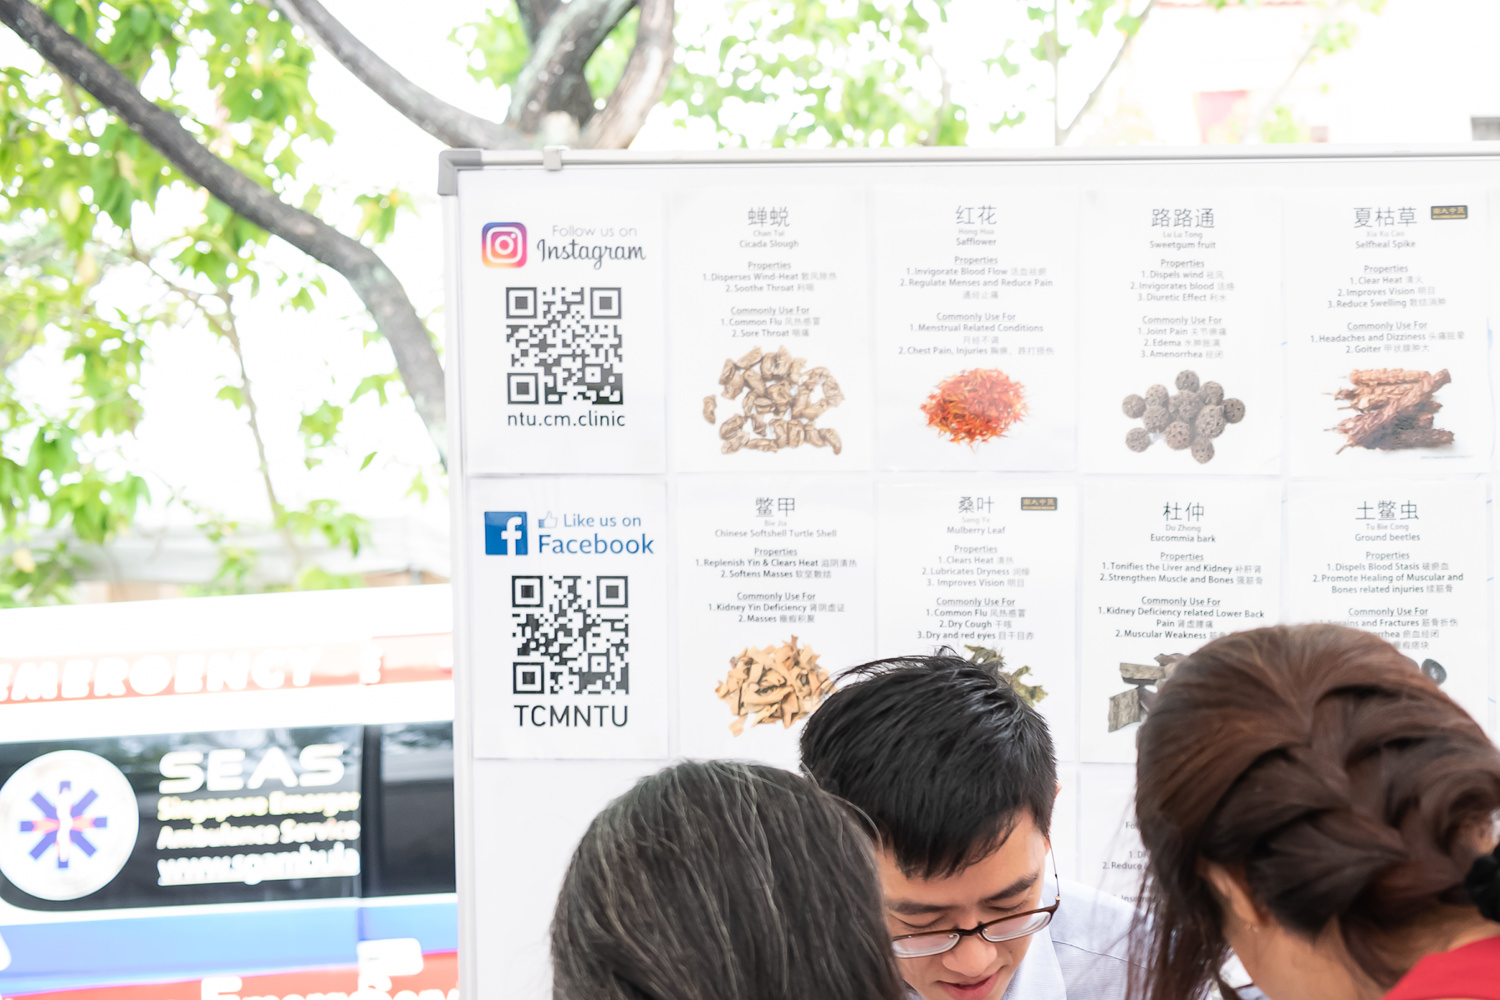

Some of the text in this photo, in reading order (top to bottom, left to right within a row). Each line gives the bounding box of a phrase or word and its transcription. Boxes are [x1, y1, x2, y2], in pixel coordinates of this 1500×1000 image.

[748, 206, 790, 227] 蝉蜕
[956, 205, 997, 225] 红花
[1152, 208, 1215, 228] 路路通
[1353, 207, 1417, 228] 夏枯草
[552, 226, 637, 237] Follow us on
[739, 240, 799, 249] Cicada Slough
[956, 238, 996, 246] Safflower
[1150, 241, 1195, 250] Sweetgum
[1356, 241, 1416, 249] Selfheal Spike
[537, 239, 646, 270] Instagram
[955, 256, 998, 265] Properties
[1161, 259, 1204, 268] Properties
[748, 262, 791, 270] Properties
[1364, 265, 1408, 273] Properties
[507, 410, 626, 427] ntu.cm.clinic
[756, 497, 795, 518] 鳖甲
[958, 496, 995, 513] 桑叶
[1163, 502, 1204, 522] 杜仲
[1355, 500, 1419, 520] 土鳖虫
[564, 514, 641, 527] Like us on
[947, 526, 1005, 535] Mulberry Leaf
[1151, 534, 1216, 543] Eucommia bark
[1355, 533, 1420, 542] Ground beetles
[538, 533, 654, 554] Facebook
[754, 548, 798, 557] Properties
[954, 545, 997, 554] Properties
[1160, 552, 1204, 562] Properties
[1366, 552, 1409, 560] Properties
[1159, 575, 1187, 583] Muscle
[1209, 576, 1234, 584] Bones
[1393, 585, 1424, 594] injuries
[514, 705, 628, 727] TCMNTU
[159, 744, 344, 793] SEAS
